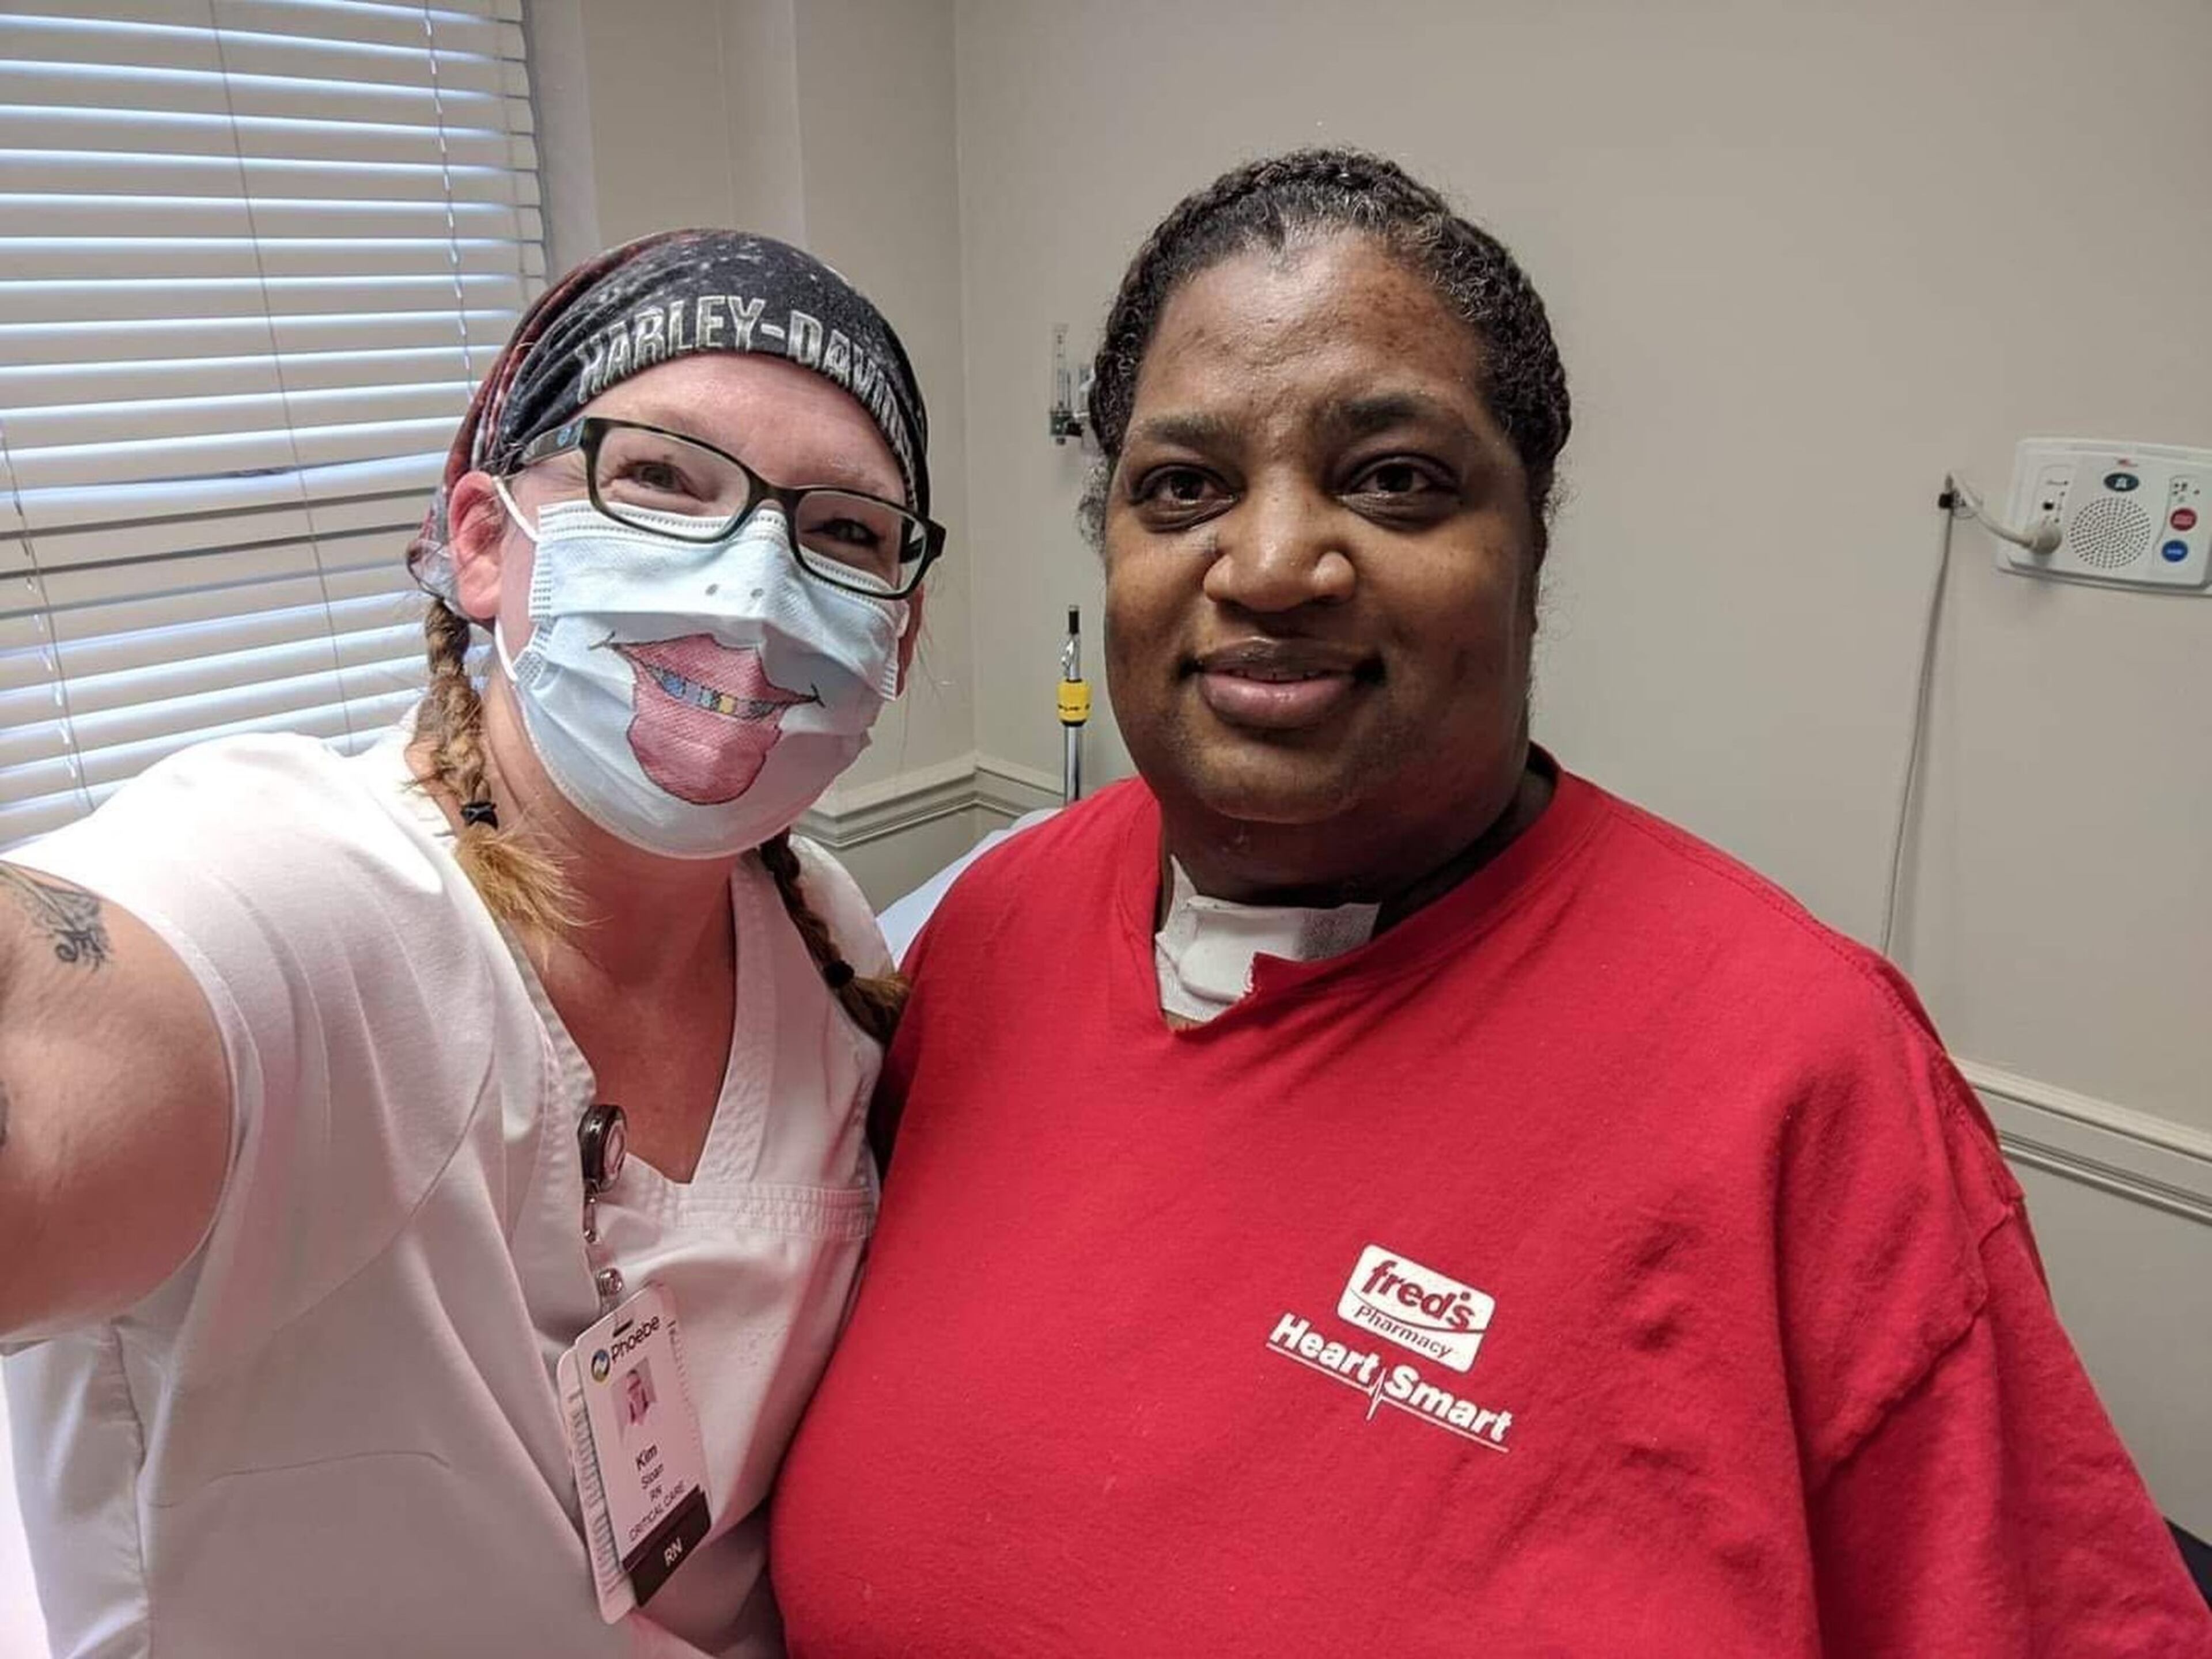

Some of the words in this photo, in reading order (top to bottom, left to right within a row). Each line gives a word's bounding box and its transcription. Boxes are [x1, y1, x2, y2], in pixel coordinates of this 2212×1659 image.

[1361, 1260, 1475, 1330] fred's
[610, 1316, 660, 1364] Phoebe
[1354, 1304, 1453, 1358] Pharmacy
[1269, 1312, 1380, 1383] Heart
[1384, 1365, 1513, 1442] Smart
[635, 1444, 658, 1471] Kim
[664, 1537, 683, 1567] RN
